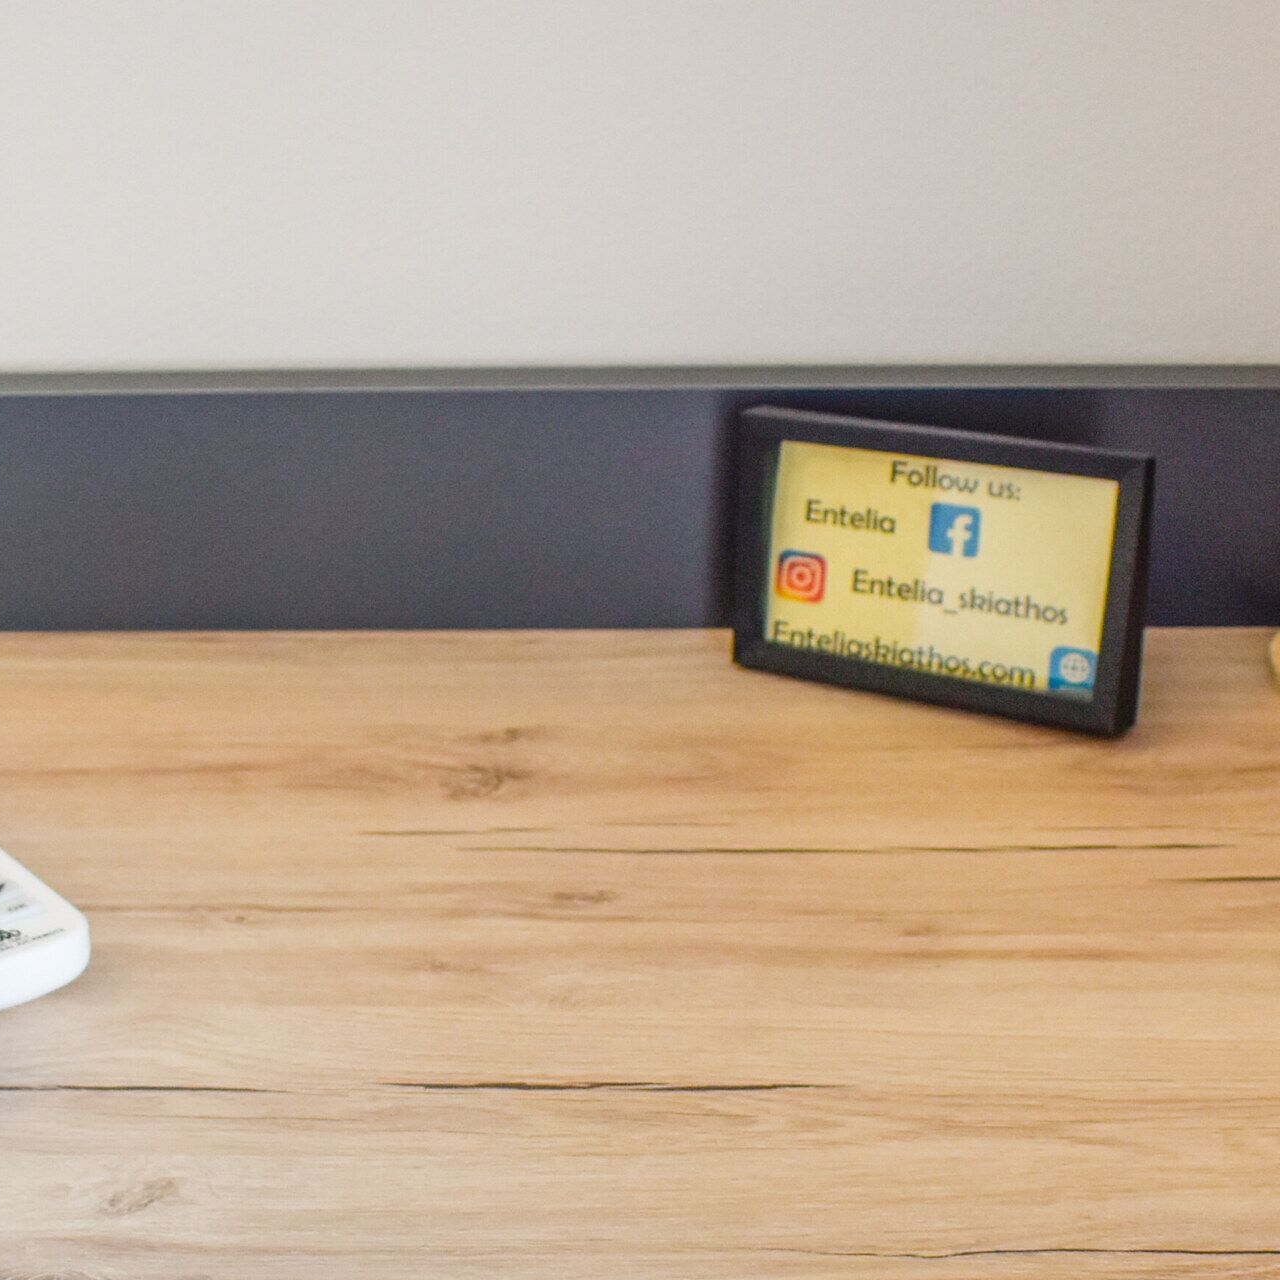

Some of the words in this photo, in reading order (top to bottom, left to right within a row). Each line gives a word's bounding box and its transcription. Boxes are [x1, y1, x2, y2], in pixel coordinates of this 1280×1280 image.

[889, 459, 979, 495] Follow
[988, 480, 1022, 501] us:
[805, 499, 896, 534] Entelia
[851, 568, 1069, 625] Entelia_skiathos
[773, 620, 1037, 689] Enteliaskiathos.com
